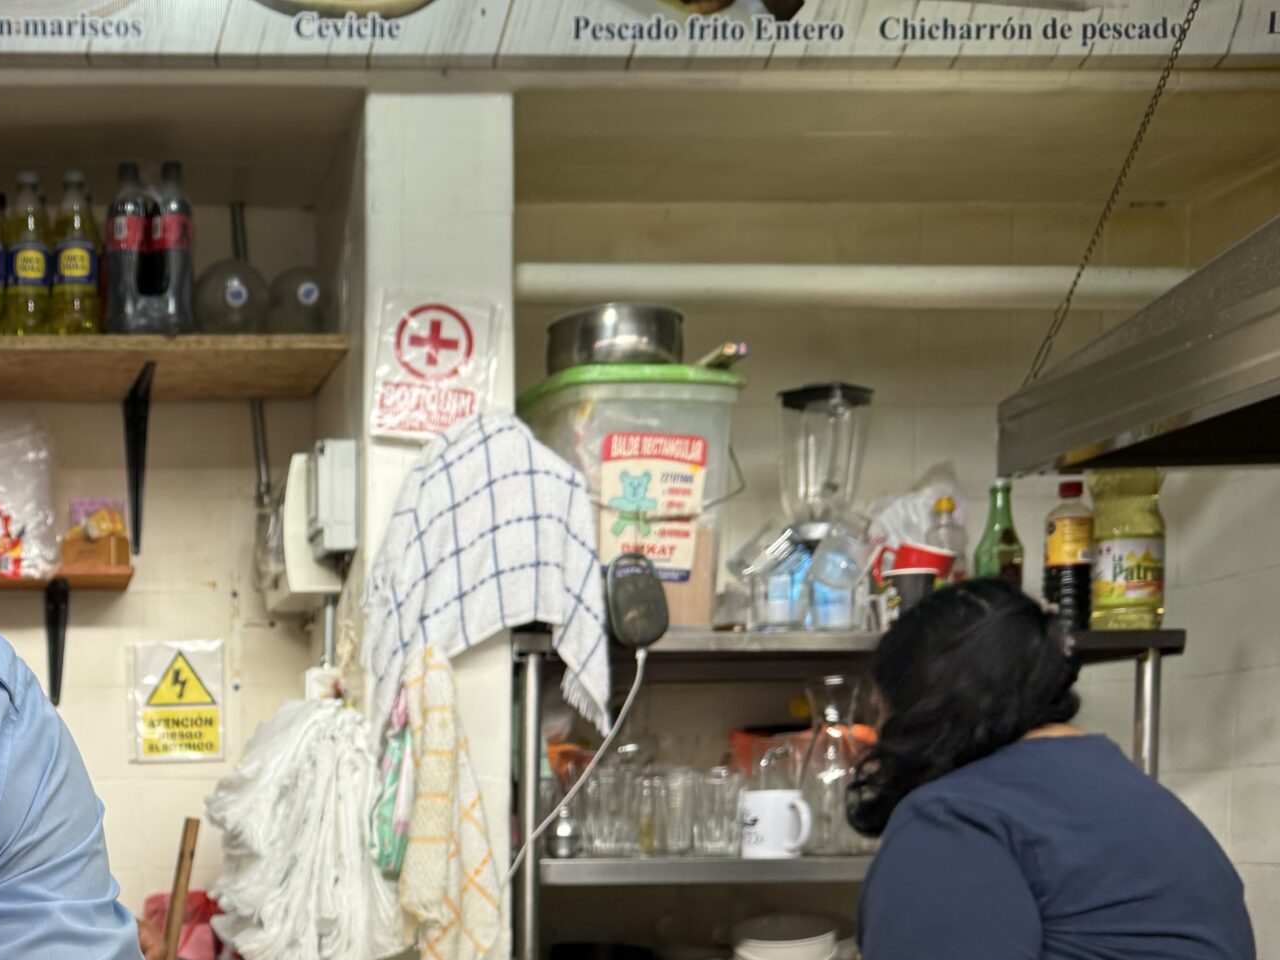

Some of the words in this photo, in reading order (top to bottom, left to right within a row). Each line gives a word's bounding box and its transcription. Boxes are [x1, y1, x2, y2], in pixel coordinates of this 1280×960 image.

[16, 14, 143, 38] mariscos
[293, 14, 401, 39] Ceviche
[573, 16, 679, 41] Pescado
[687, 16, 746, 41] frito
[754, 16, 845, 41] Entero
[879, 16, 1034, 42] Chicharrón
[1042, 17, 1073, 41] de
[1081, 17, 1184, 46] pescado
